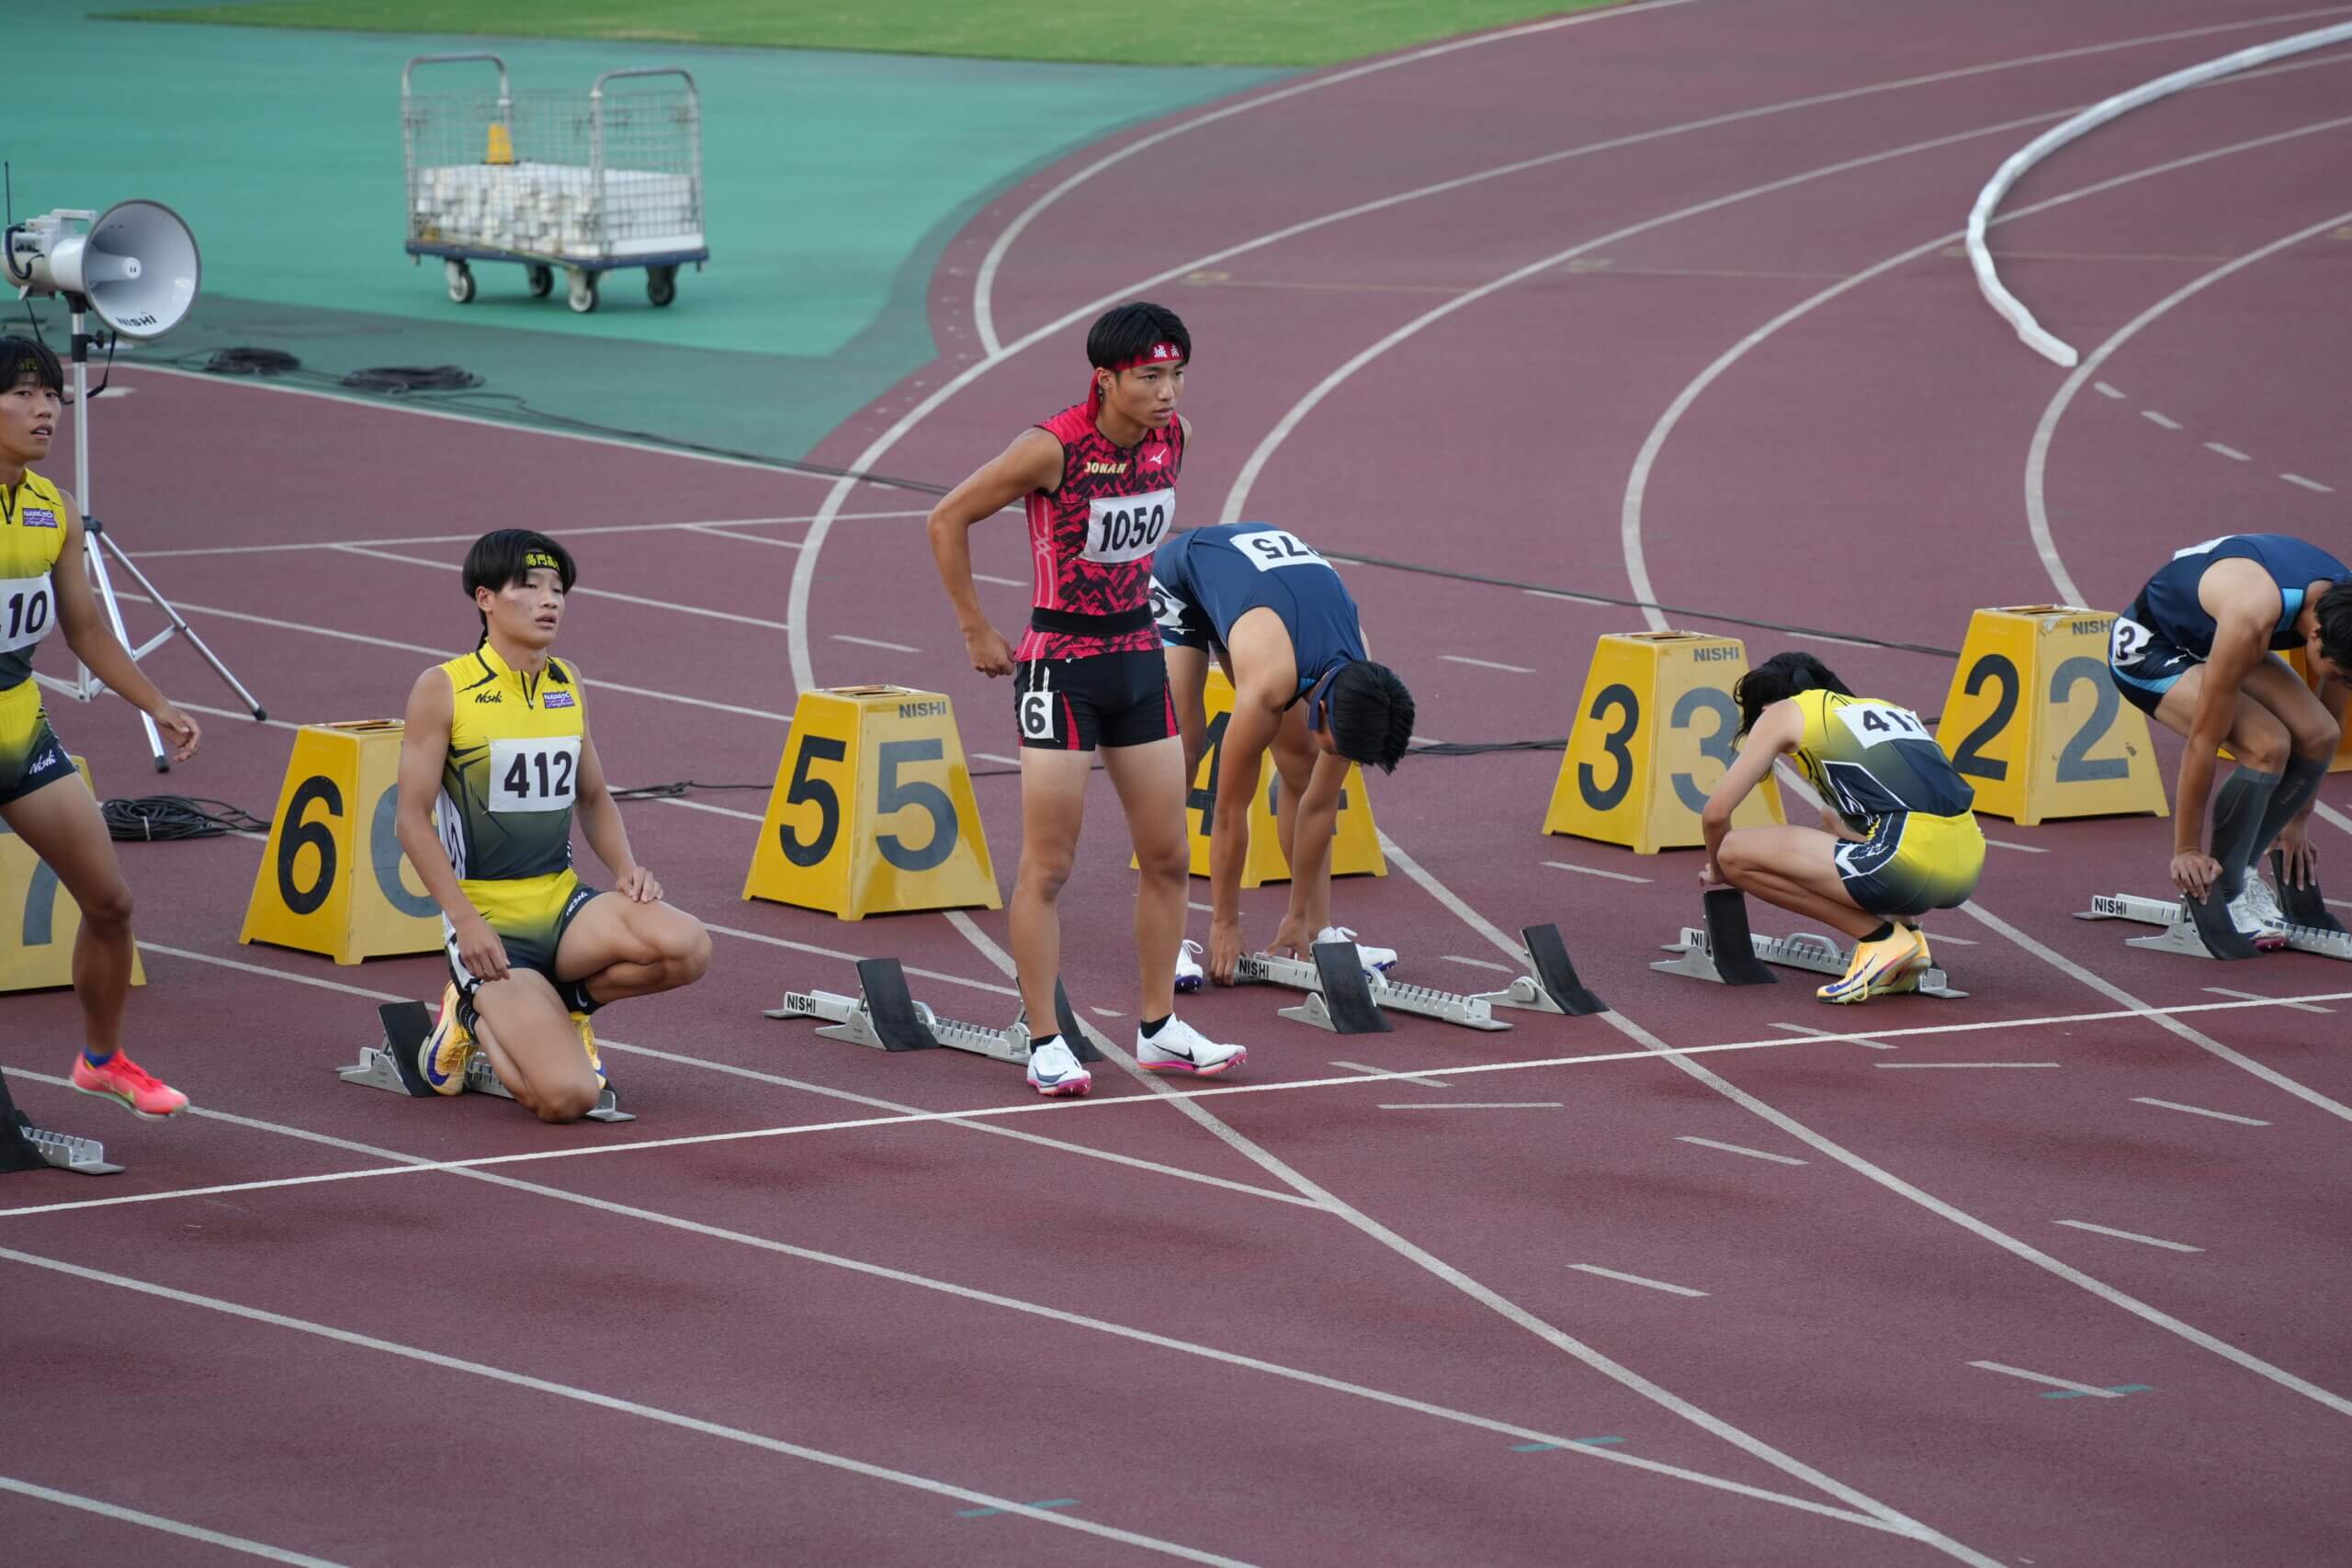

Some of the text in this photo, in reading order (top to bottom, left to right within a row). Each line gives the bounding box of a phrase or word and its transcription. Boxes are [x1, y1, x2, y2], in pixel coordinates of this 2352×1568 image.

[116, 315, 157, 327] NISHI
[1084, 462, 1127, 474] JONAN
[1100, 504, 1164, 552] 1050
[1251, 536, 1323, 560] 75
[0, 591, 48, 639] 10
[2073, 620, 2113, 636] NISH
[1693, 647, 1741, 662] NISHI
[899, 701, 947, 718] NISHI
[1024, 696, 1046, 735] 6
[1951, 653, 2019, 782] 2
[2050, 656, 2139, 783] 2
[1578, 683, 1640, 811] 3
[1670, 686, 1741, 816] 3
[503, 750, 572, 798] 412
[1185, 711, 1232, 837] 4
[779, 735, 847, 867] 5
[876, 739, 959, 872] 5
[277, 775, 344, 915] 6
[2095, 897, 2127, 915] NISHI
[1238, 957, 1270, 978] NISHI
[787, 994, 816, 1014] NISHI
